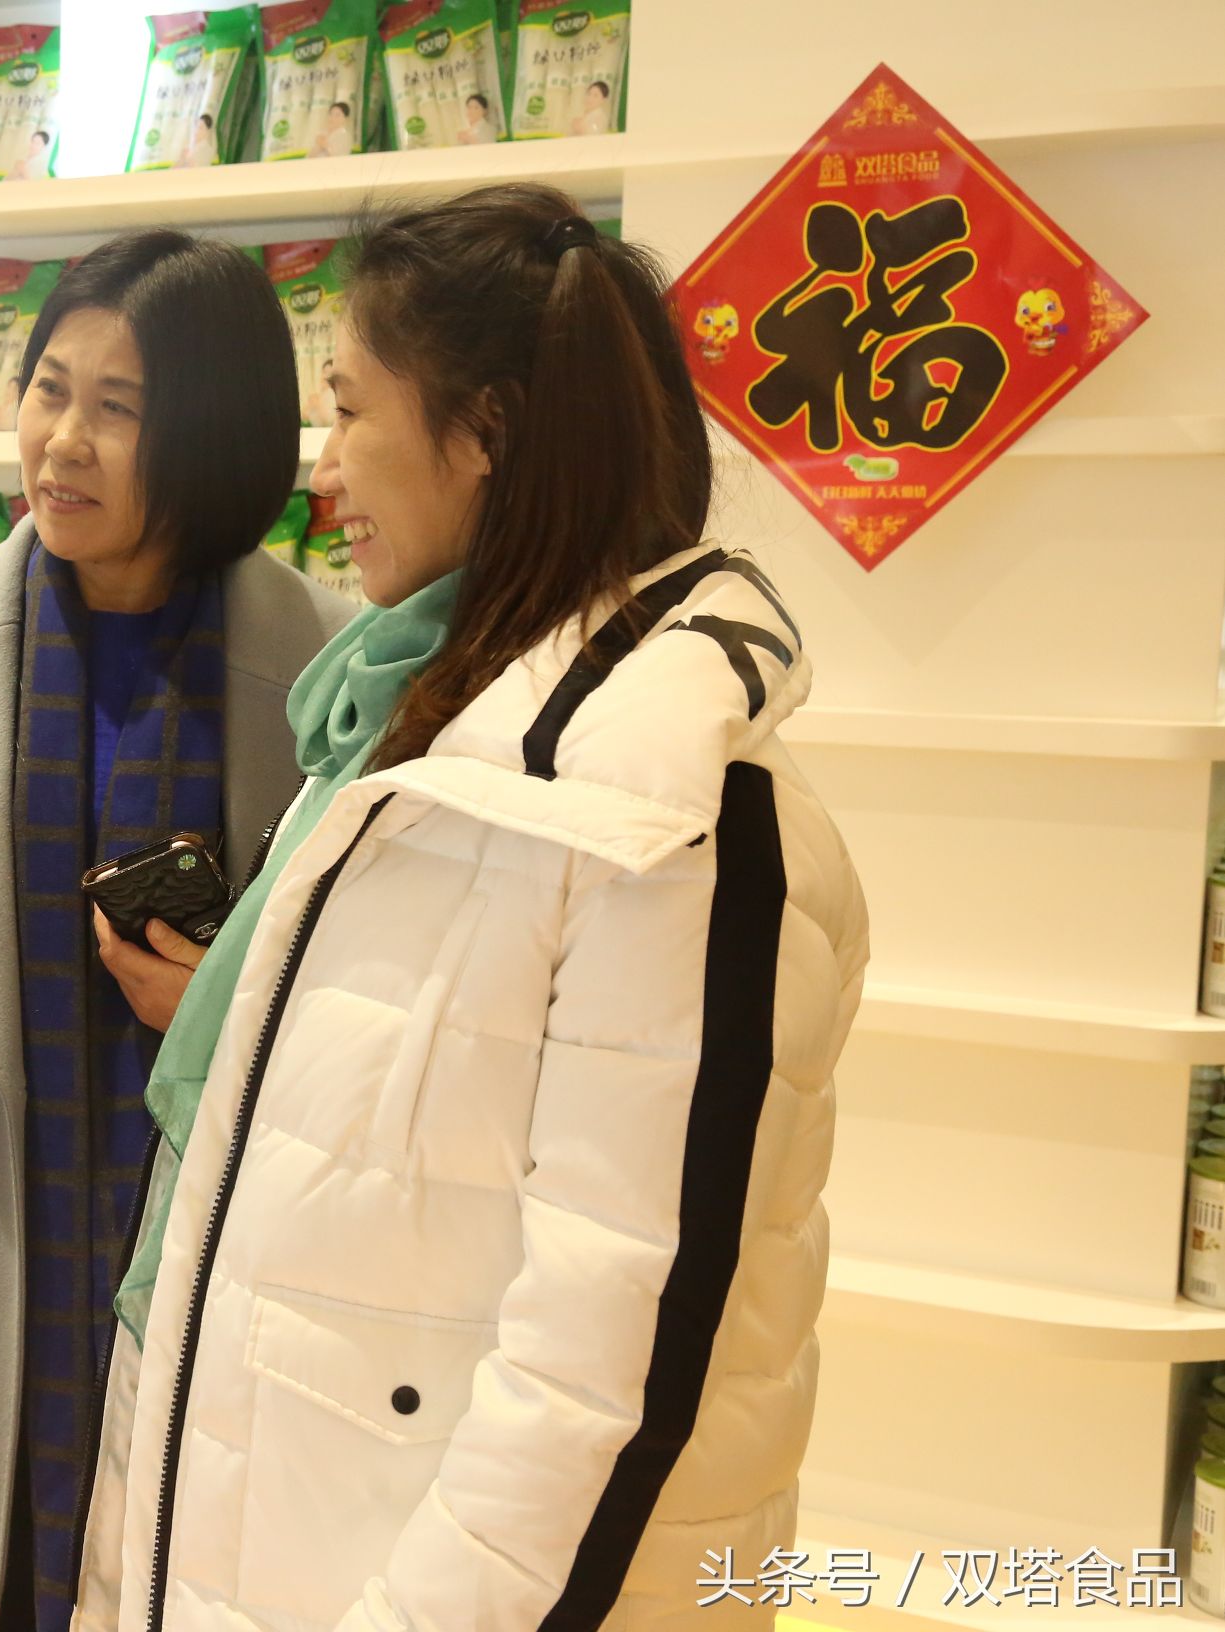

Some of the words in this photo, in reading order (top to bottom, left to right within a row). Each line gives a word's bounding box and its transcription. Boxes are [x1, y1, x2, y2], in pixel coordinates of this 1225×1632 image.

[855, 150, 941, 177] 双塔食品
[745, 194, 1011, 453] 福
